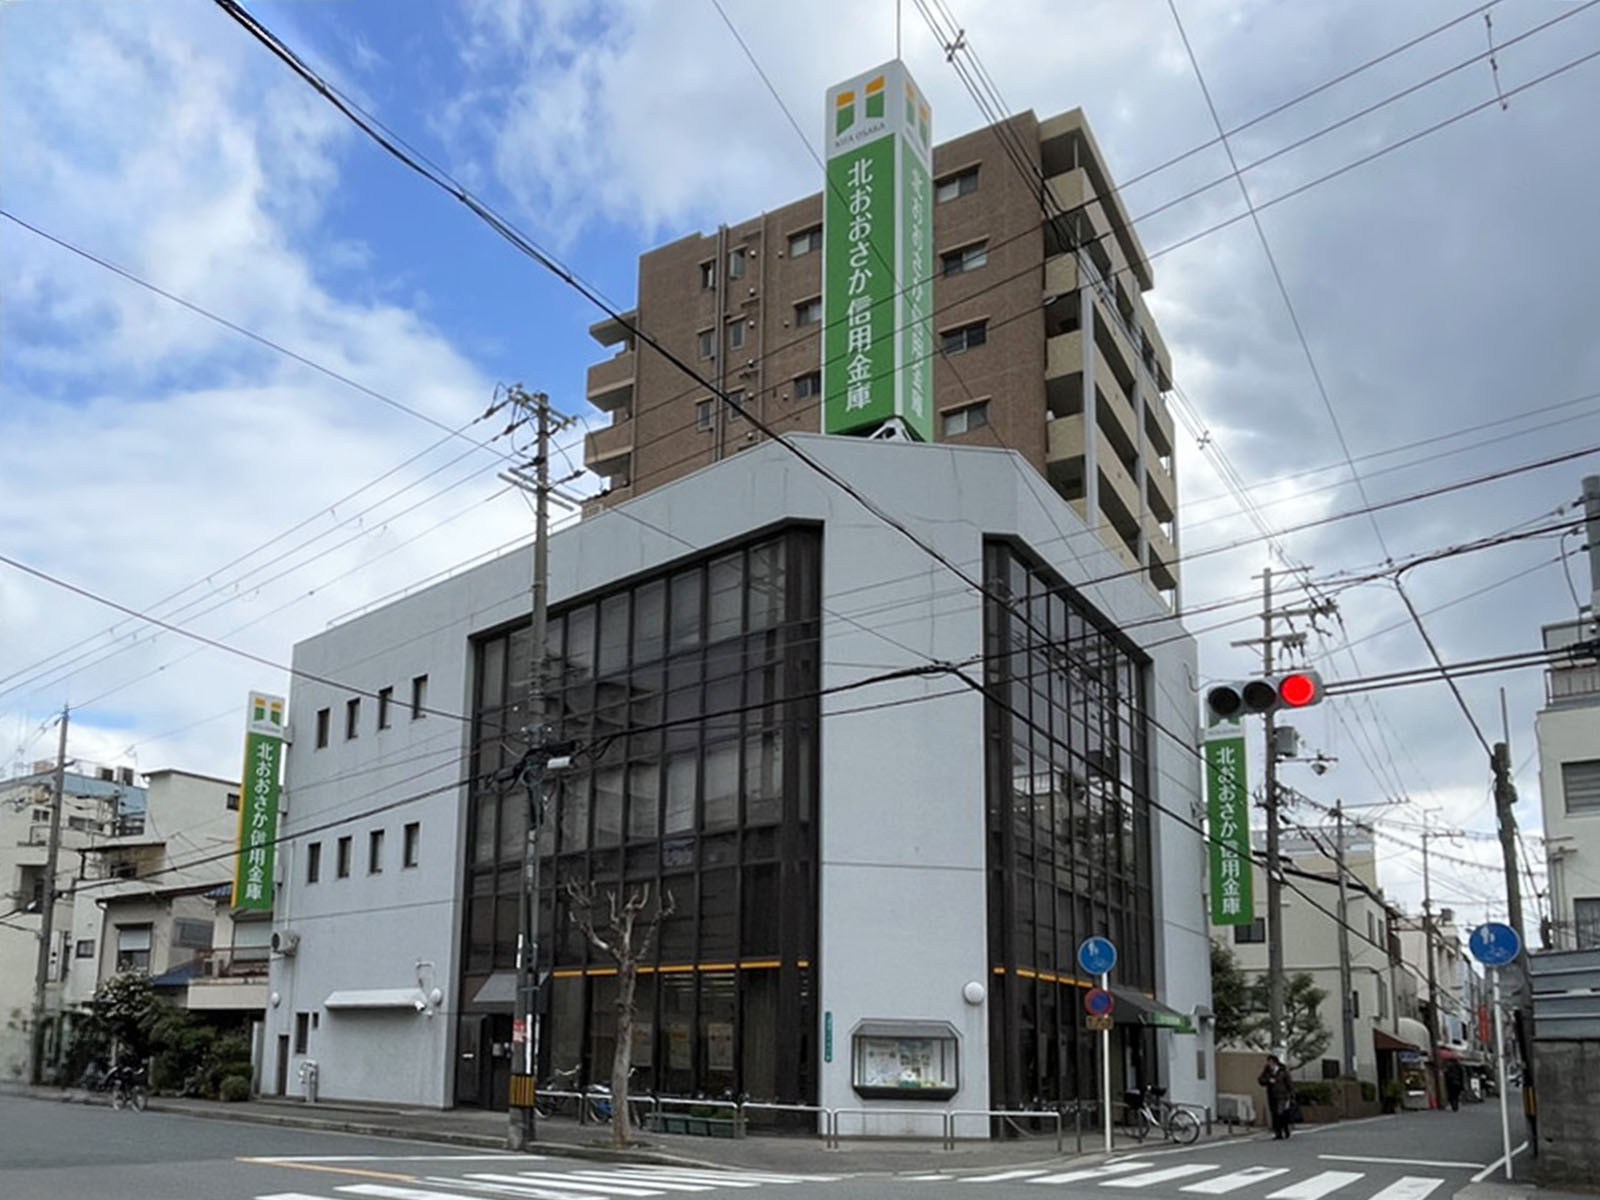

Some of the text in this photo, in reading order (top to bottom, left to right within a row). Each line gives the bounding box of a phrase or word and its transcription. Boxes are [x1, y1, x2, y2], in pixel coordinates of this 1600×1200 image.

[846, 158, 873, 412] 北おおさか信用金庫
